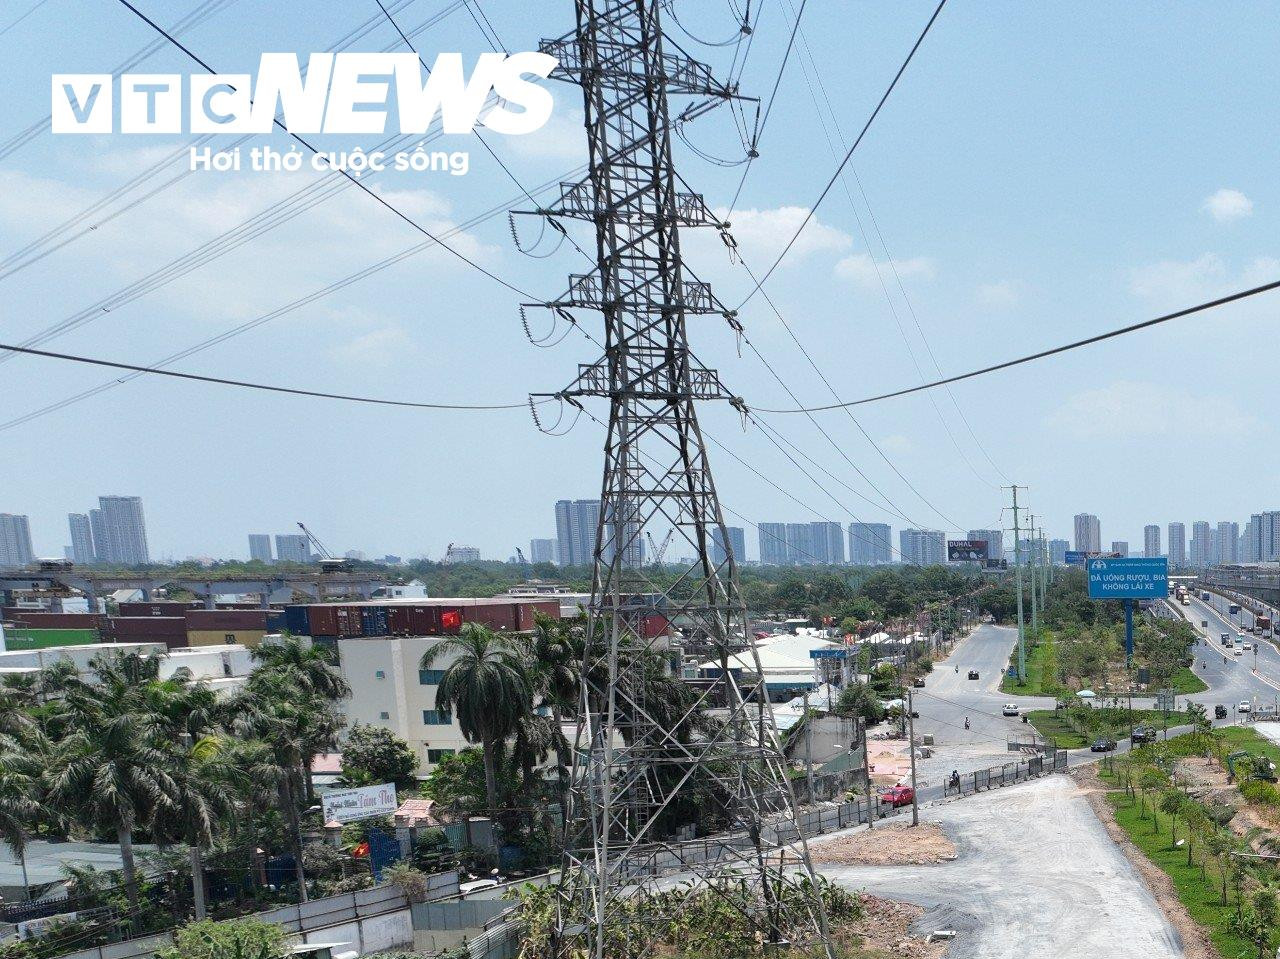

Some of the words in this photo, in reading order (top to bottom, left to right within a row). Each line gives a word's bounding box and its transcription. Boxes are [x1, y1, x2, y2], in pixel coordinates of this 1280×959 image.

[1090, 573, 1102, 582] ĐÃ
[1103, 573, 1125, 581] UỐNG
[1102, 582, 1130, 590] KHÔNG
[1131, 582, 1143, 590] LÁI
